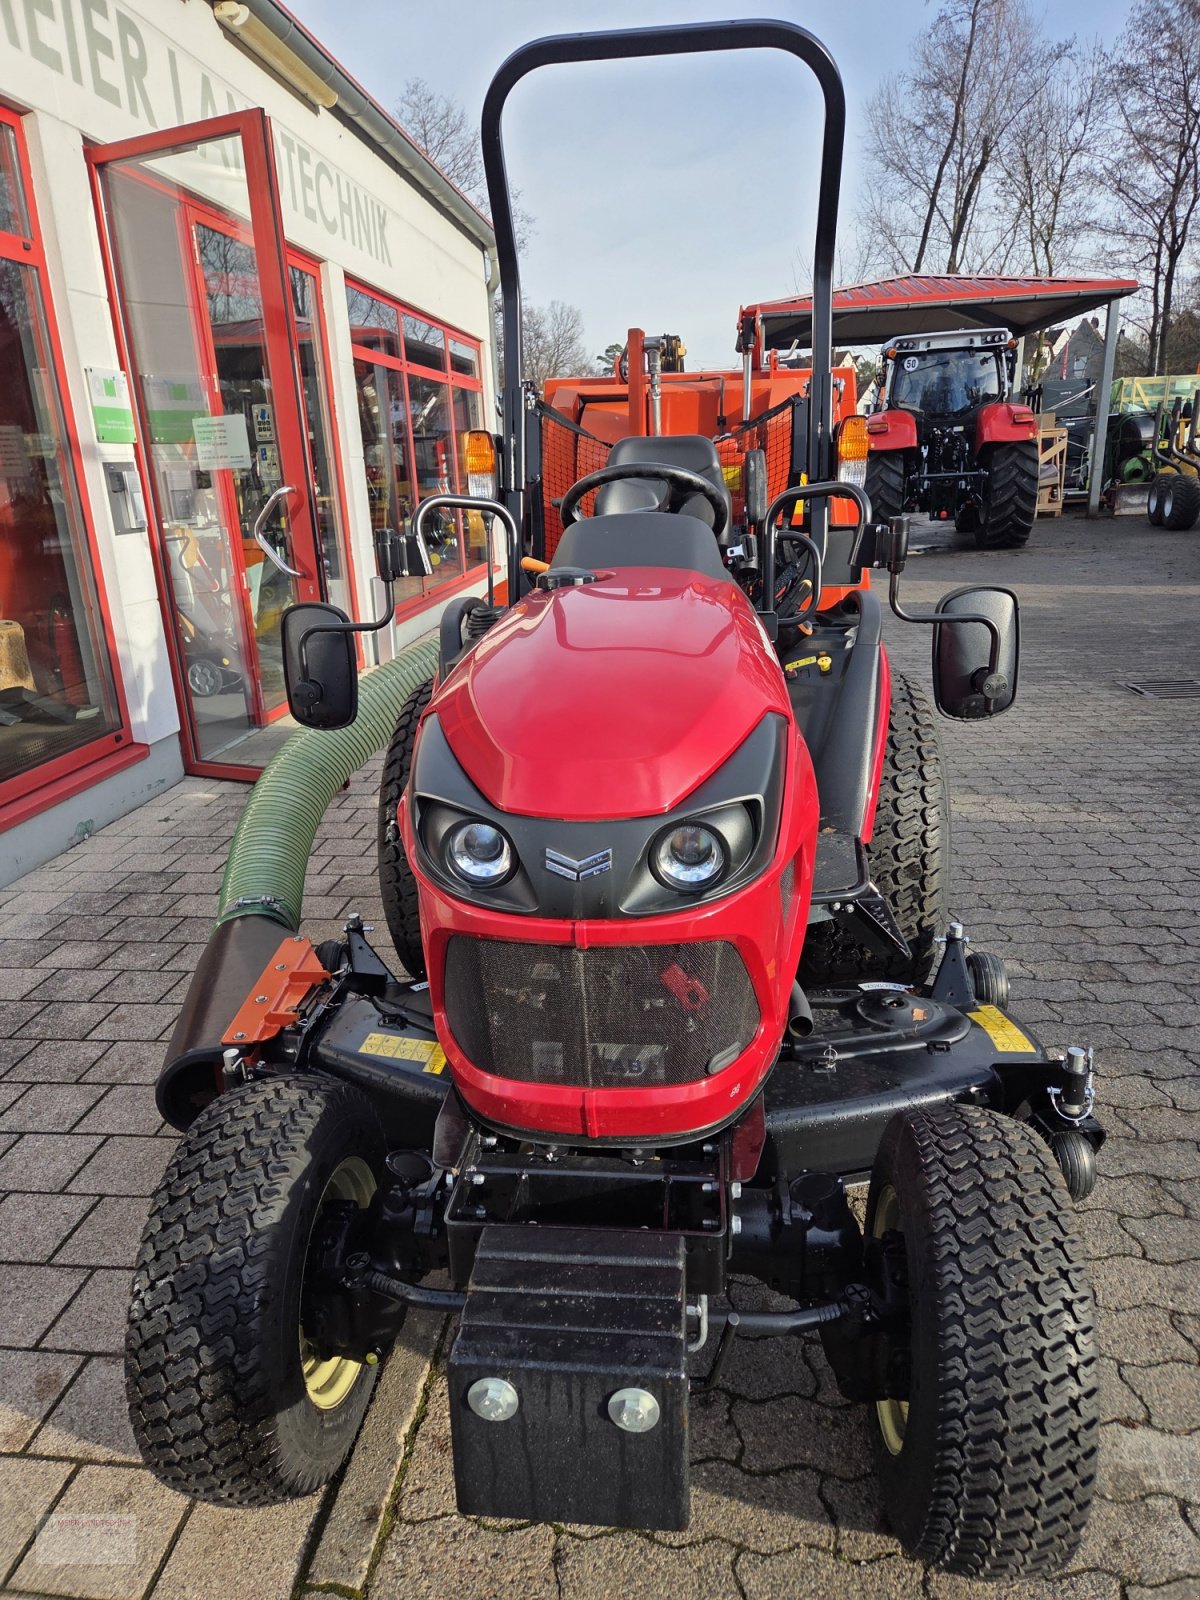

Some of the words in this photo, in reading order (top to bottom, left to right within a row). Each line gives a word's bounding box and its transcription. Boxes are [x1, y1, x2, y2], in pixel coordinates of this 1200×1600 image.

[0, 0, 158, 129] EIER
[167, 47, 392, 268] LATECHNIK
[906, 359, 917, 369] 50
